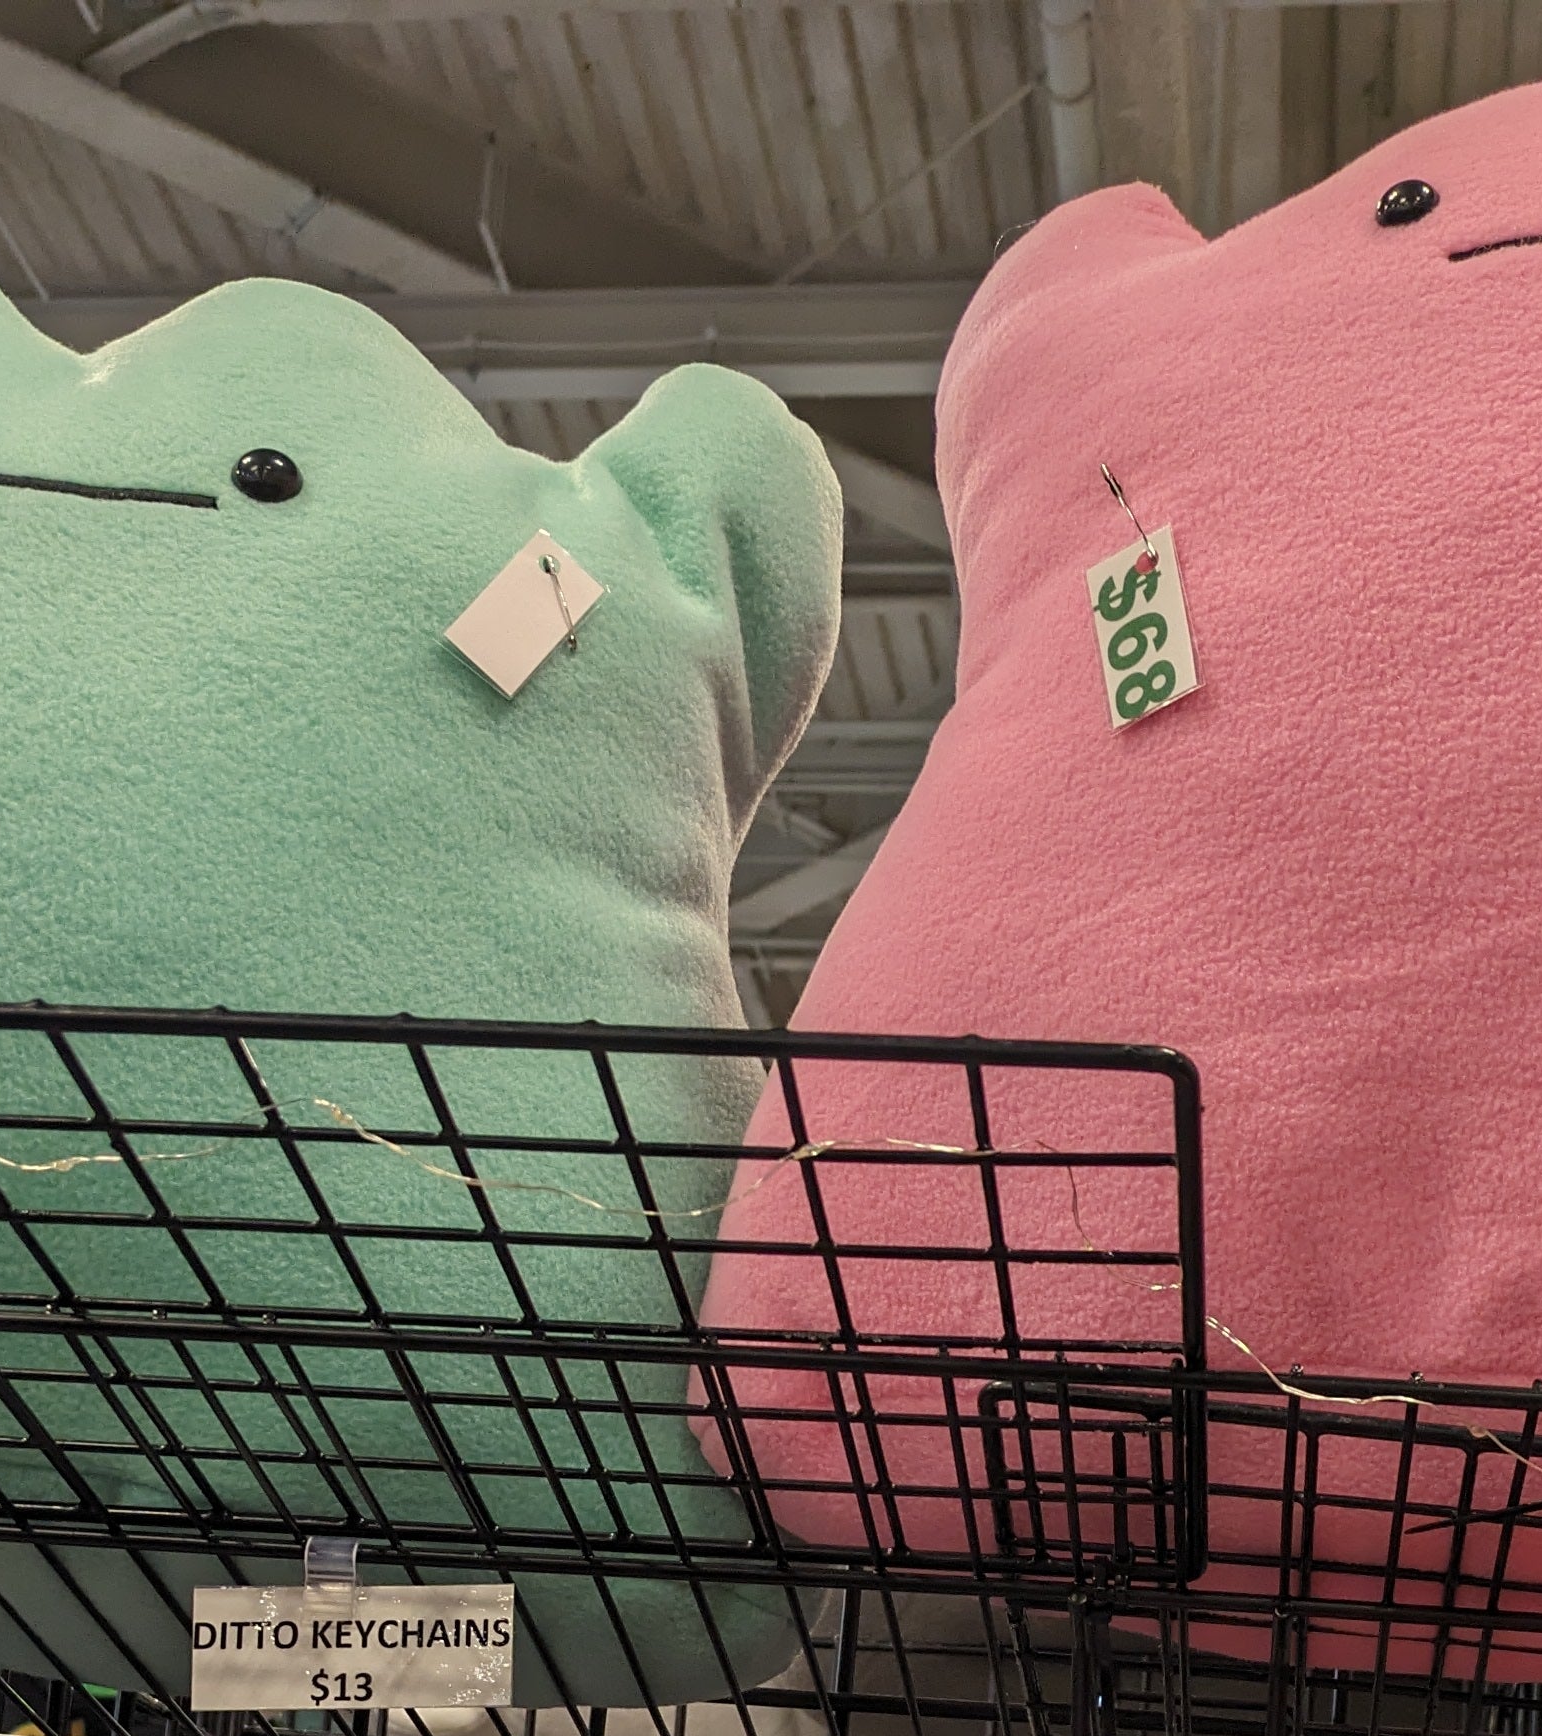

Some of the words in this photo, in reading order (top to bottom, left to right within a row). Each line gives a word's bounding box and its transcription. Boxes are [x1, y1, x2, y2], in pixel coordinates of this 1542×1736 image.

[1092, 565, 1176, 719] $68
[194, 1621, 299, 1650] DITTO
[312, 1618, 511, 1650] KEYCHAINS
[310, 1669, 373, 1705] $13
